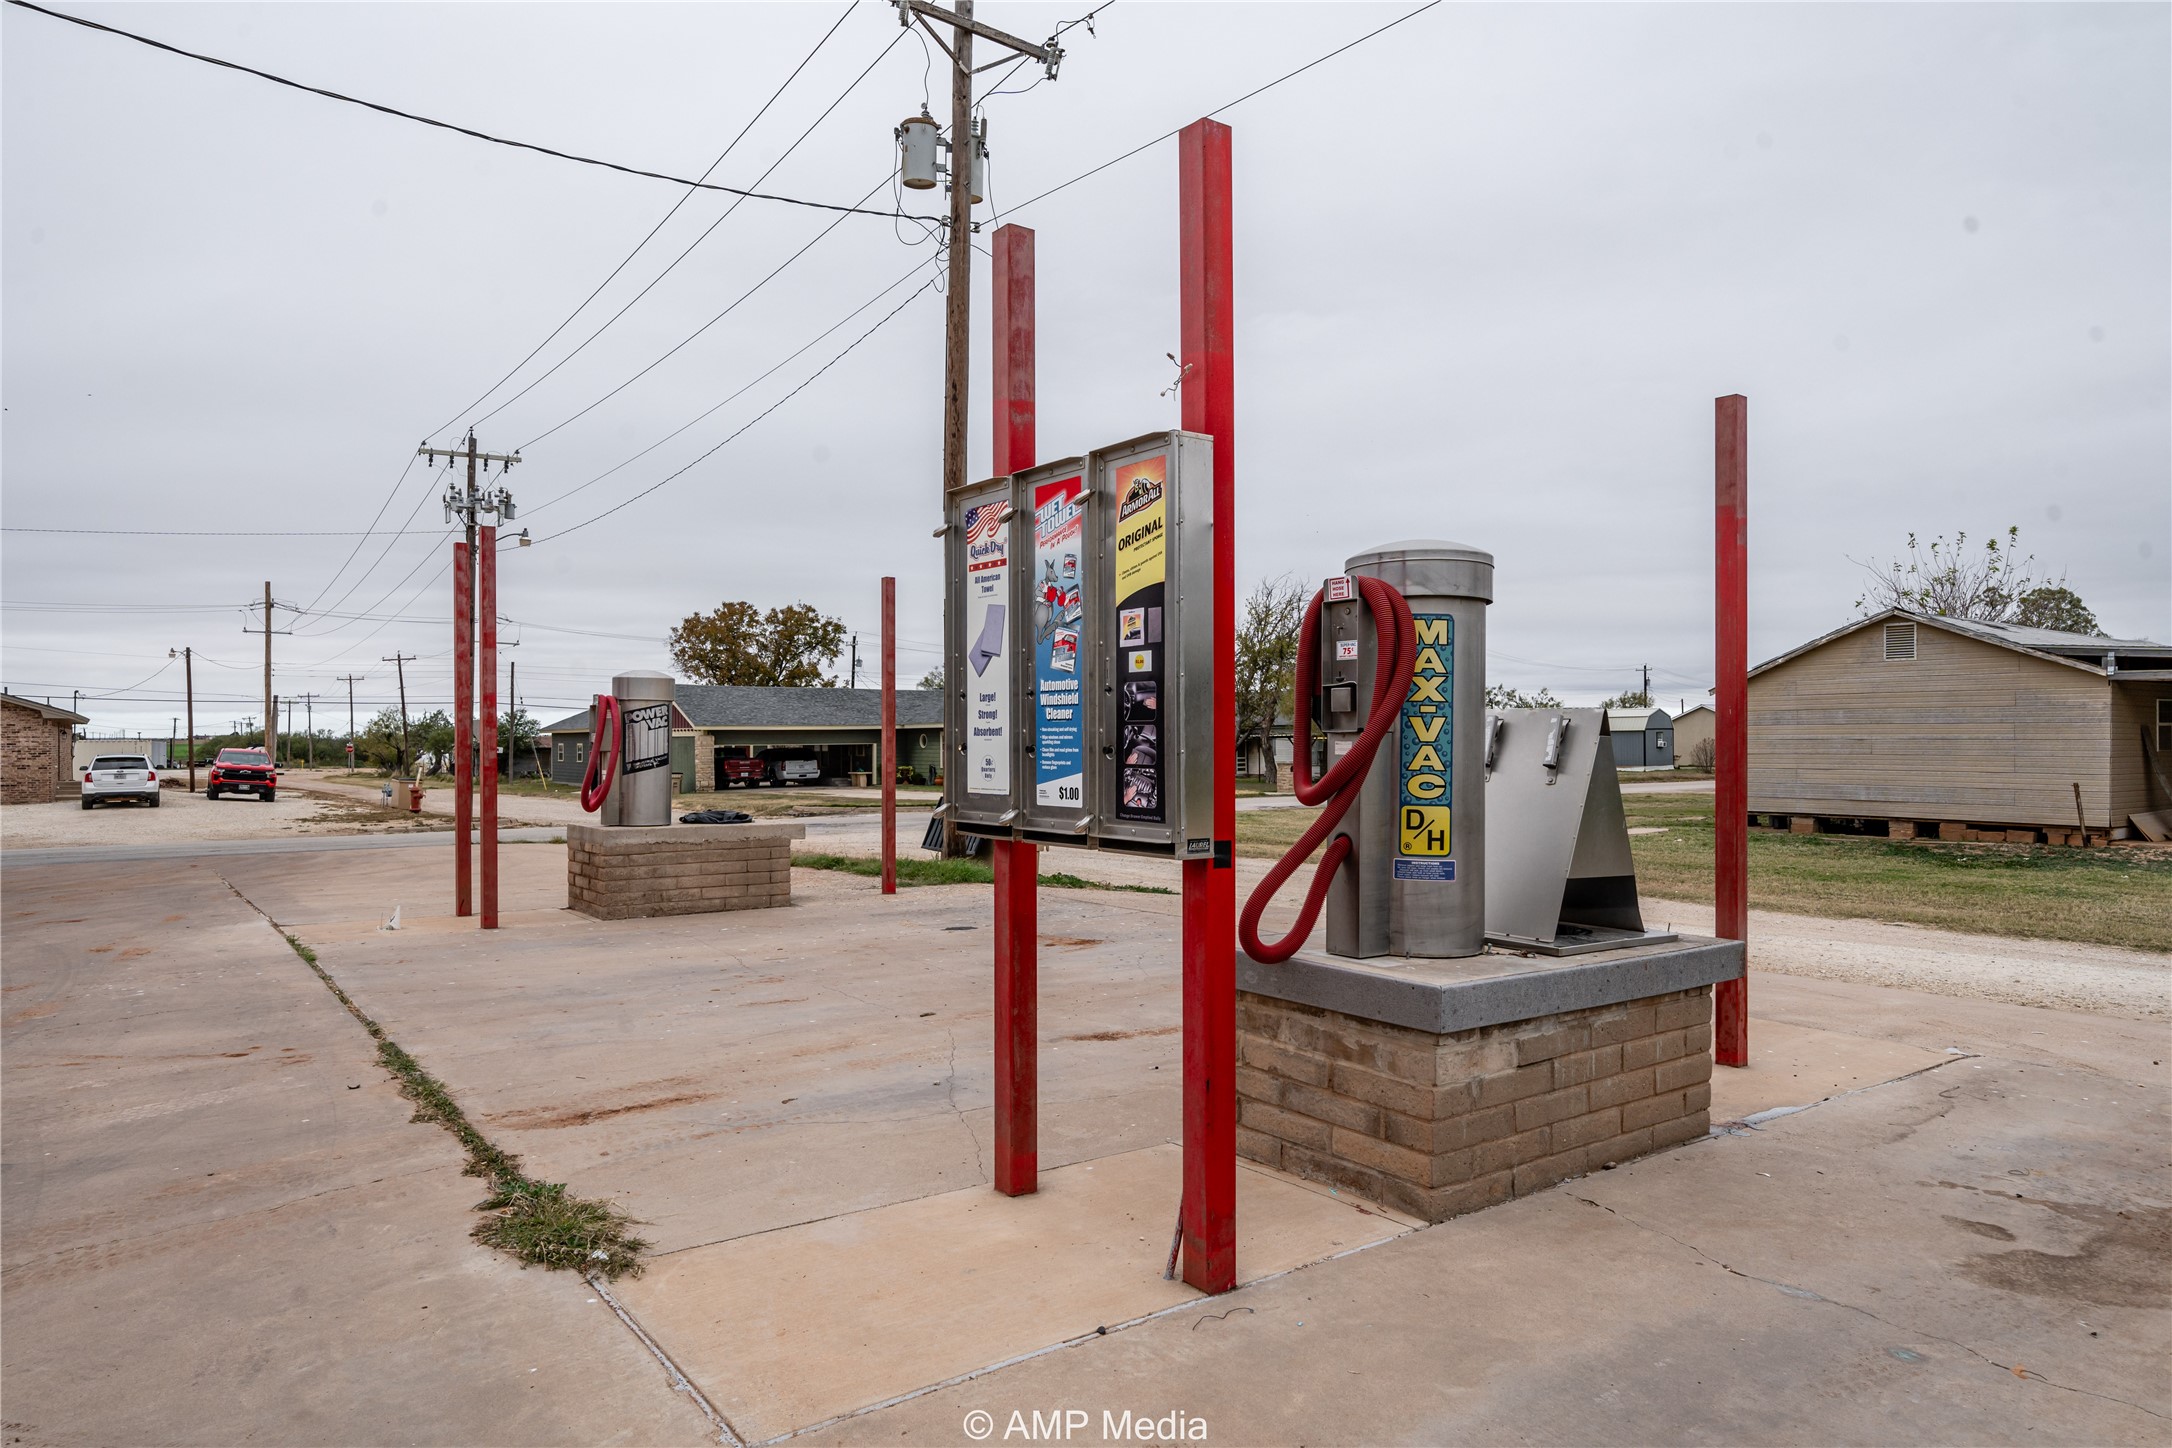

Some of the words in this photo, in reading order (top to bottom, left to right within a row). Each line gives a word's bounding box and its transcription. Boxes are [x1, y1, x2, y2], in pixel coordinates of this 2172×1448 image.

[1035, 492, 1065, 524] WET
[1035, 502, 1082, 539] TOWEL
[1118, 516, 1163, 551] ORIGINAL
[981, 573, 1000, 583] American
[981, 584, 994, 593] Towel
[1040, 678, 1079, 691] Automotive
[979, 692, 996, 703] Large!
[1040, 692, 1079, 706] Windshield
[624, 705, 669, 724] POWER
[978, 709, 998, 720] Strong!
[1046, 707, 1073, 720] Cleaner
[1406, 618, 1449, 799] MAX-VAC
[645, 715, 668, 730] VAC
[973, 726, 1002, 737] Absorbent!
[1059, 786, 1079, 800] $1.00
